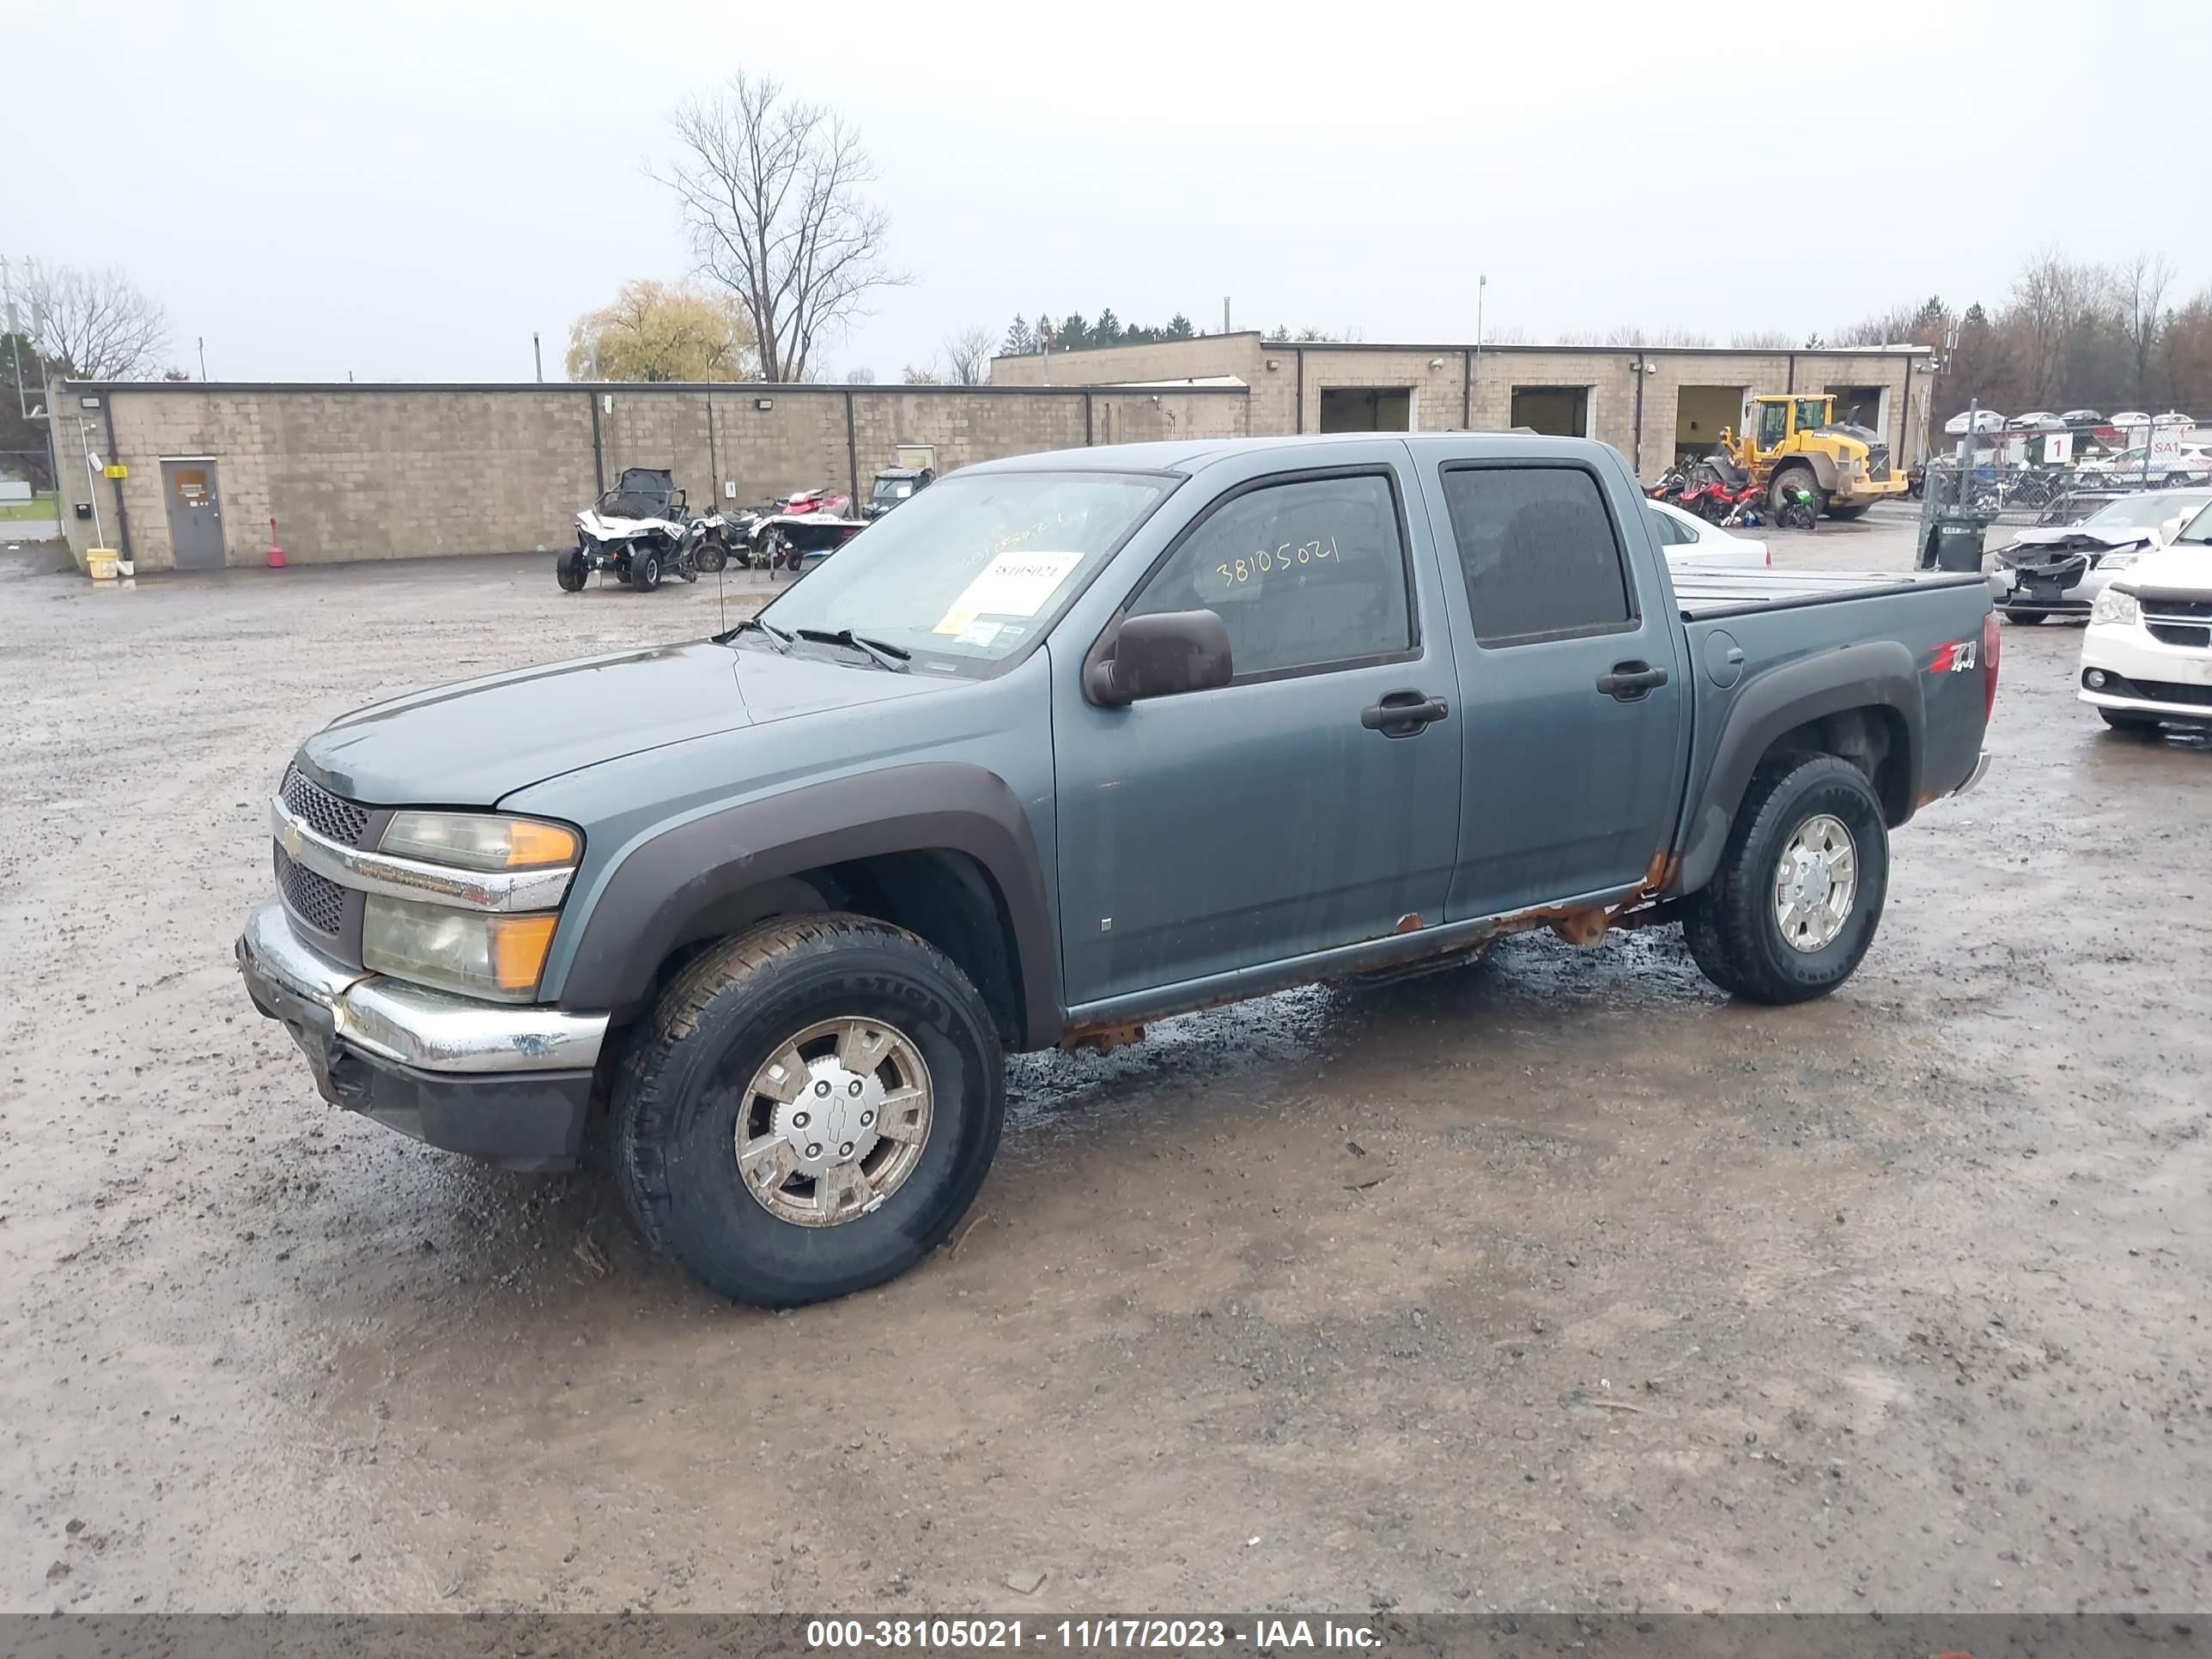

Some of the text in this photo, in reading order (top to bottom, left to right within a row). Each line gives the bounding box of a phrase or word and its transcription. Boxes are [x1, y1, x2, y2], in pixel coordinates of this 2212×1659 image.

[2053, 440, 2062, 458] 1
[2154, 441, 2179, 453] SA1
[1216, 536, 1340, 588] 38105021
[1929, 640, 1977, 674] Z71
